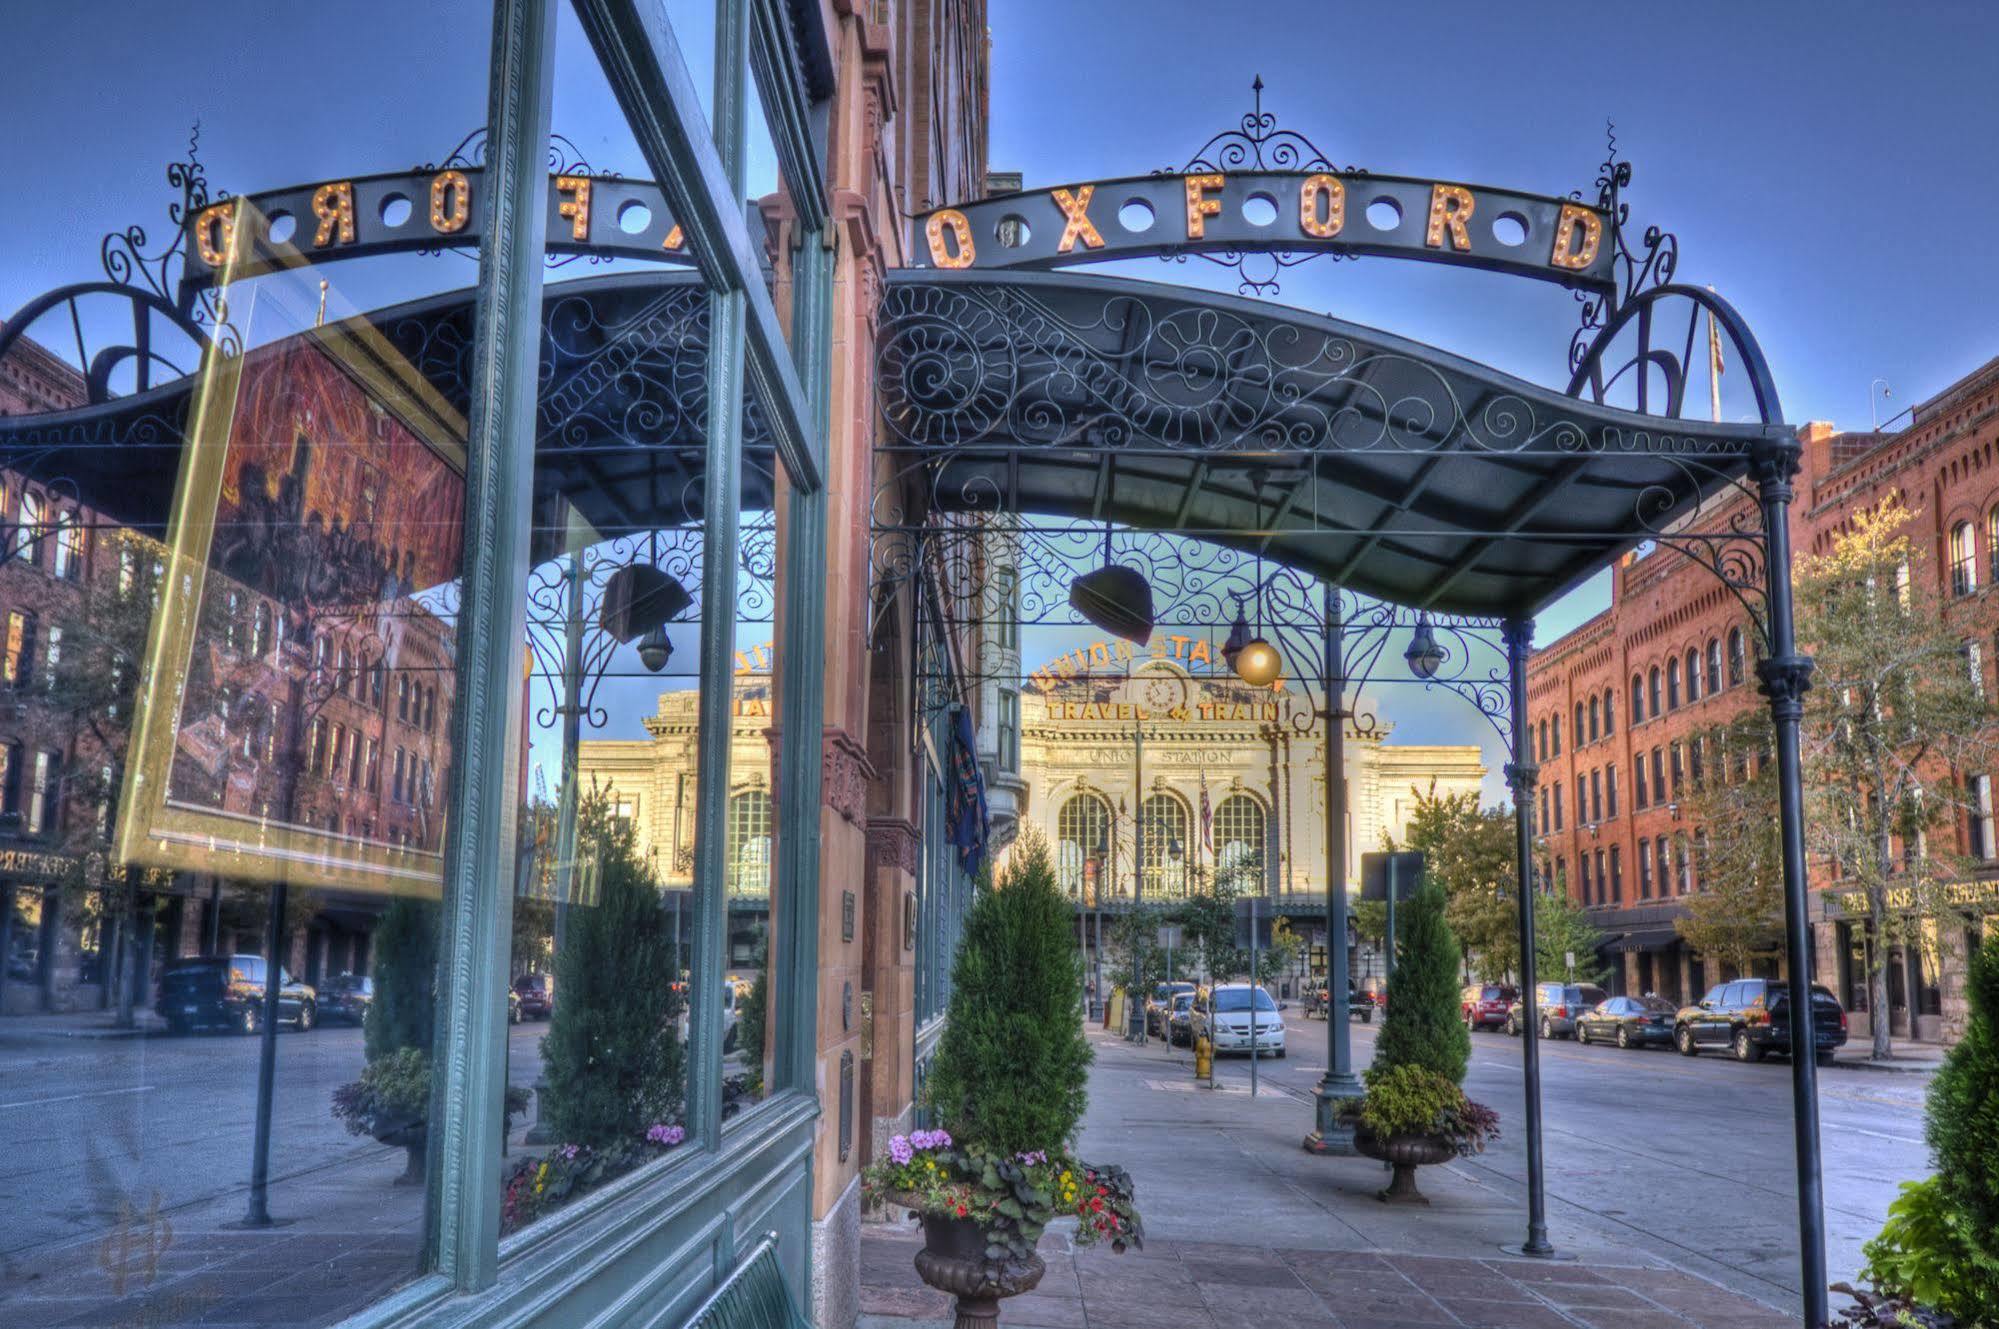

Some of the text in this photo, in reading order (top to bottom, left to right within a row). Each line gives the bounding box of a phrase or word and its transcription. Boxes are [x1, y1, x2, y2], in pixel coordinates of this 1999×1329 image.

[926, 175, 1602, 269] OXFORD
[1031, 640, 1133, 691] UNION
[1046, 702, 1150, 720] TRAVEL
[1198, 702, 1278, 720] TRAIN
[1089, 751, 1232, 763] UNIO STATION
